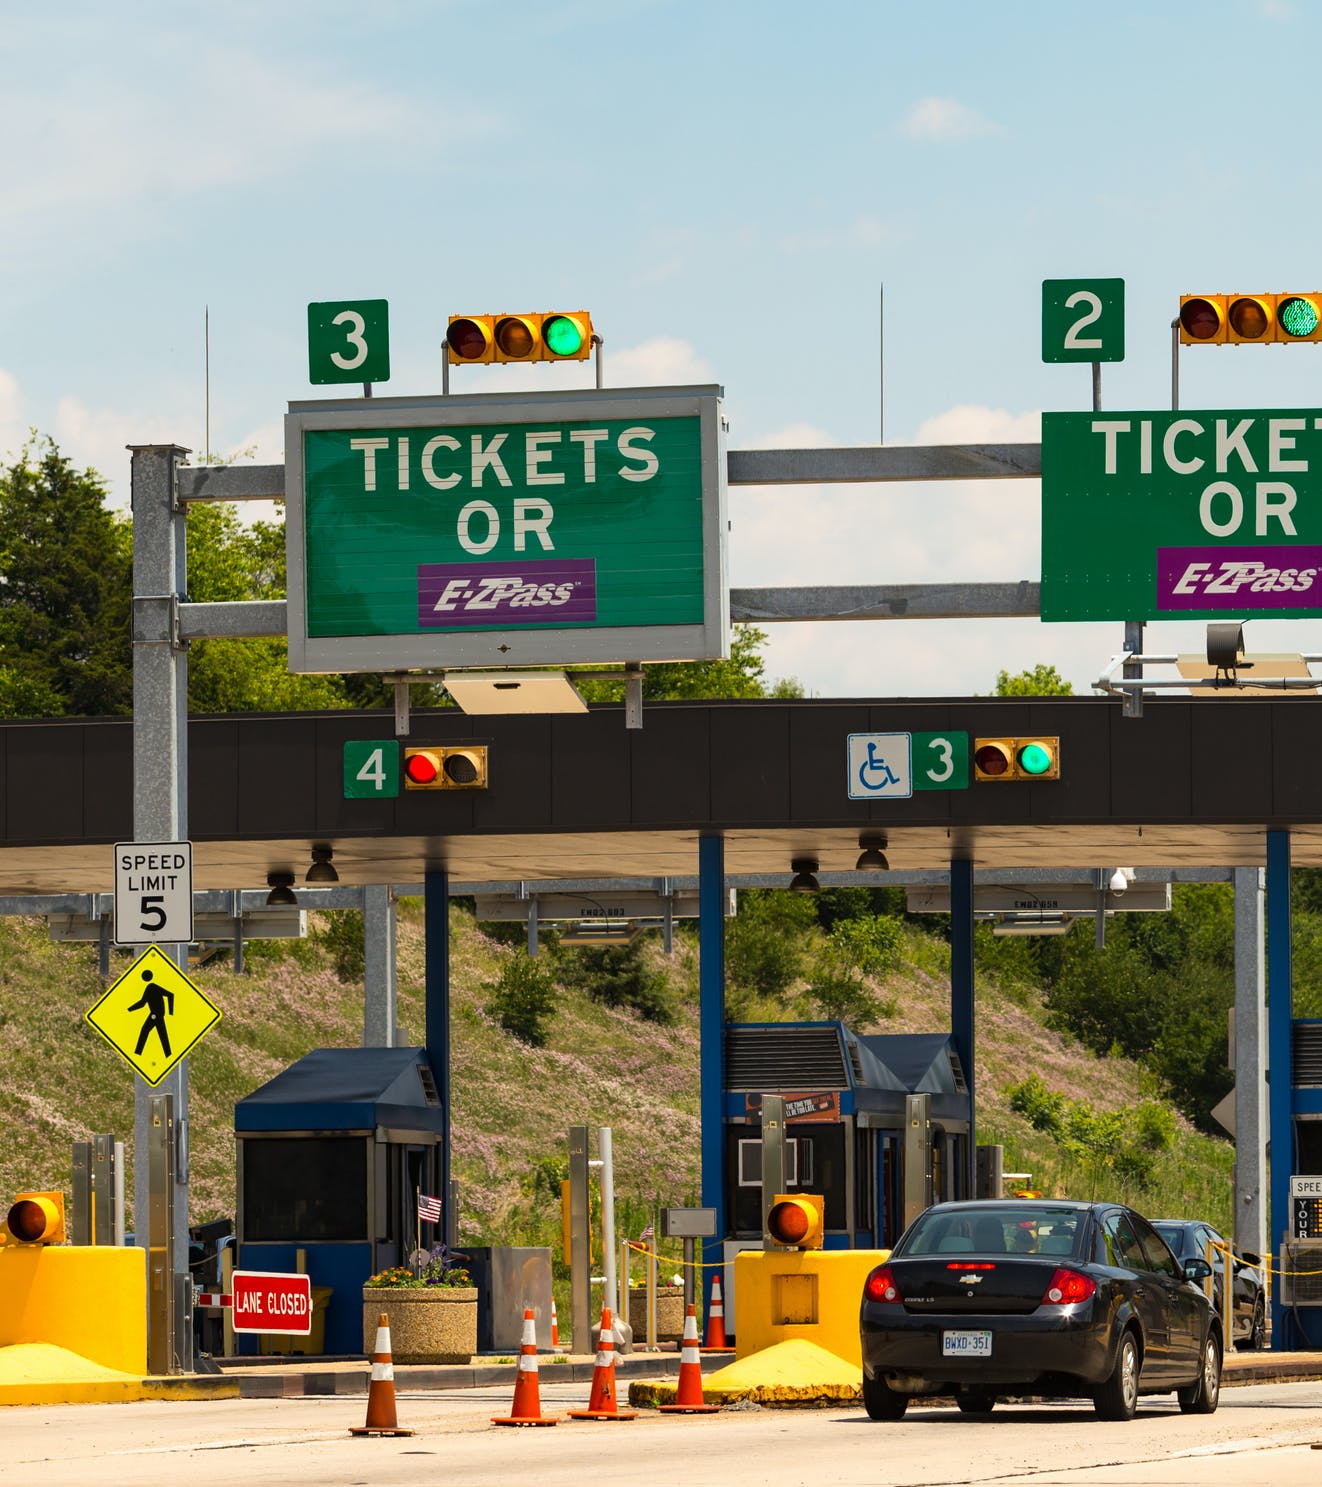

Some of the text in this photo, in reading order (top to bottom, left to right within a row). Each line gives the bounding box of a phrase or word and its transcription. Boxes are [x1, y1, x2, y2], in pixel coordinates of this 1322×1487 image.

[329, 310, 368, 370] 3
[1064, 290, 1103, 349] 2
[350, 427, 660, 491] TICKETS
[457, 497, 555, 555] OR
[1199, 480, 1298, 537] OR
[356, 748, 387, 790] 4
[926, 737, 954, 783] 3
[122, 855, 185, 870] SPEED
[129, 876, 178, 891] LIMIT
[140, 896, 167, 931] 5
[1299, 1200, 1308, 1238] YOUR
[236, 1291, 307, 1315] LANE CLOSED
